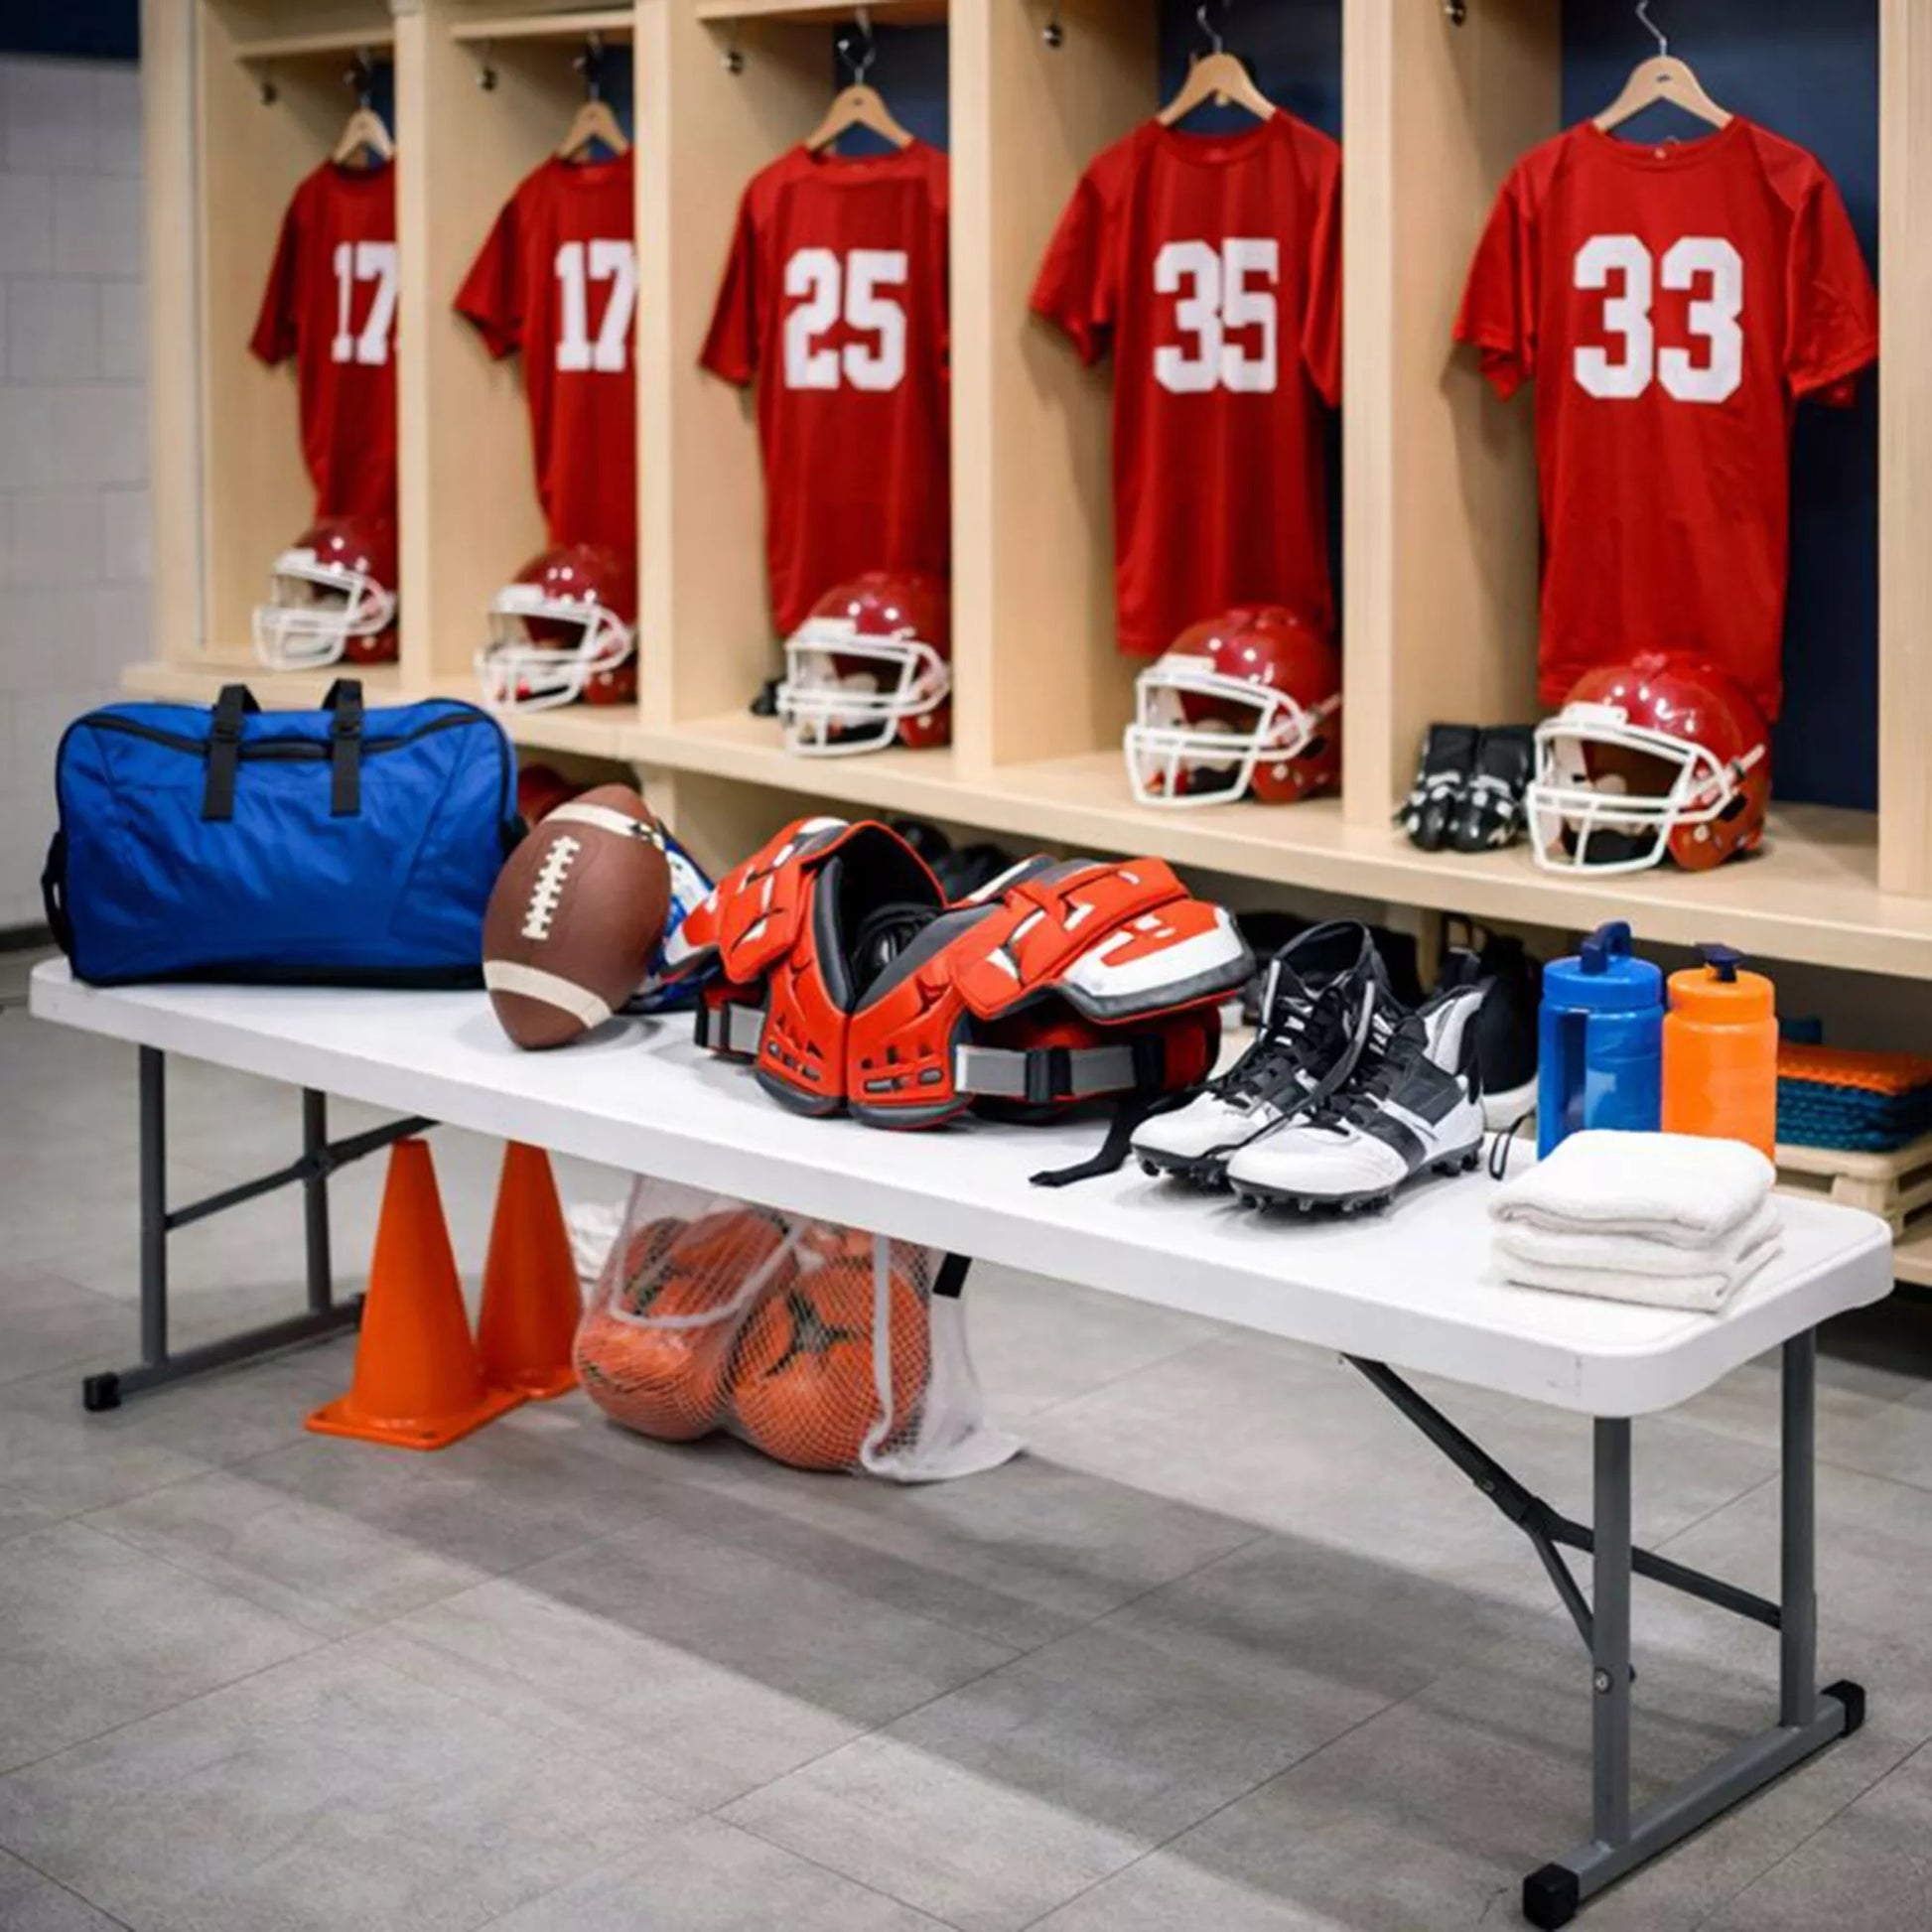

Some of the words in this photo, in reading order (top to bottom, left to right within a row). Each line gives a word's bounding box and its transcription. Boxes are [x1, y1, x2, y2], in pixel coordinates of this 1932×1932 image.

[332, 241, 397, 364] 17
[554, 239, 635, 371] 17
[784, 248, 907, 390] 25
[1154, 237, 1279, 393] 35
[1574, 234, 1743, 403] 33
